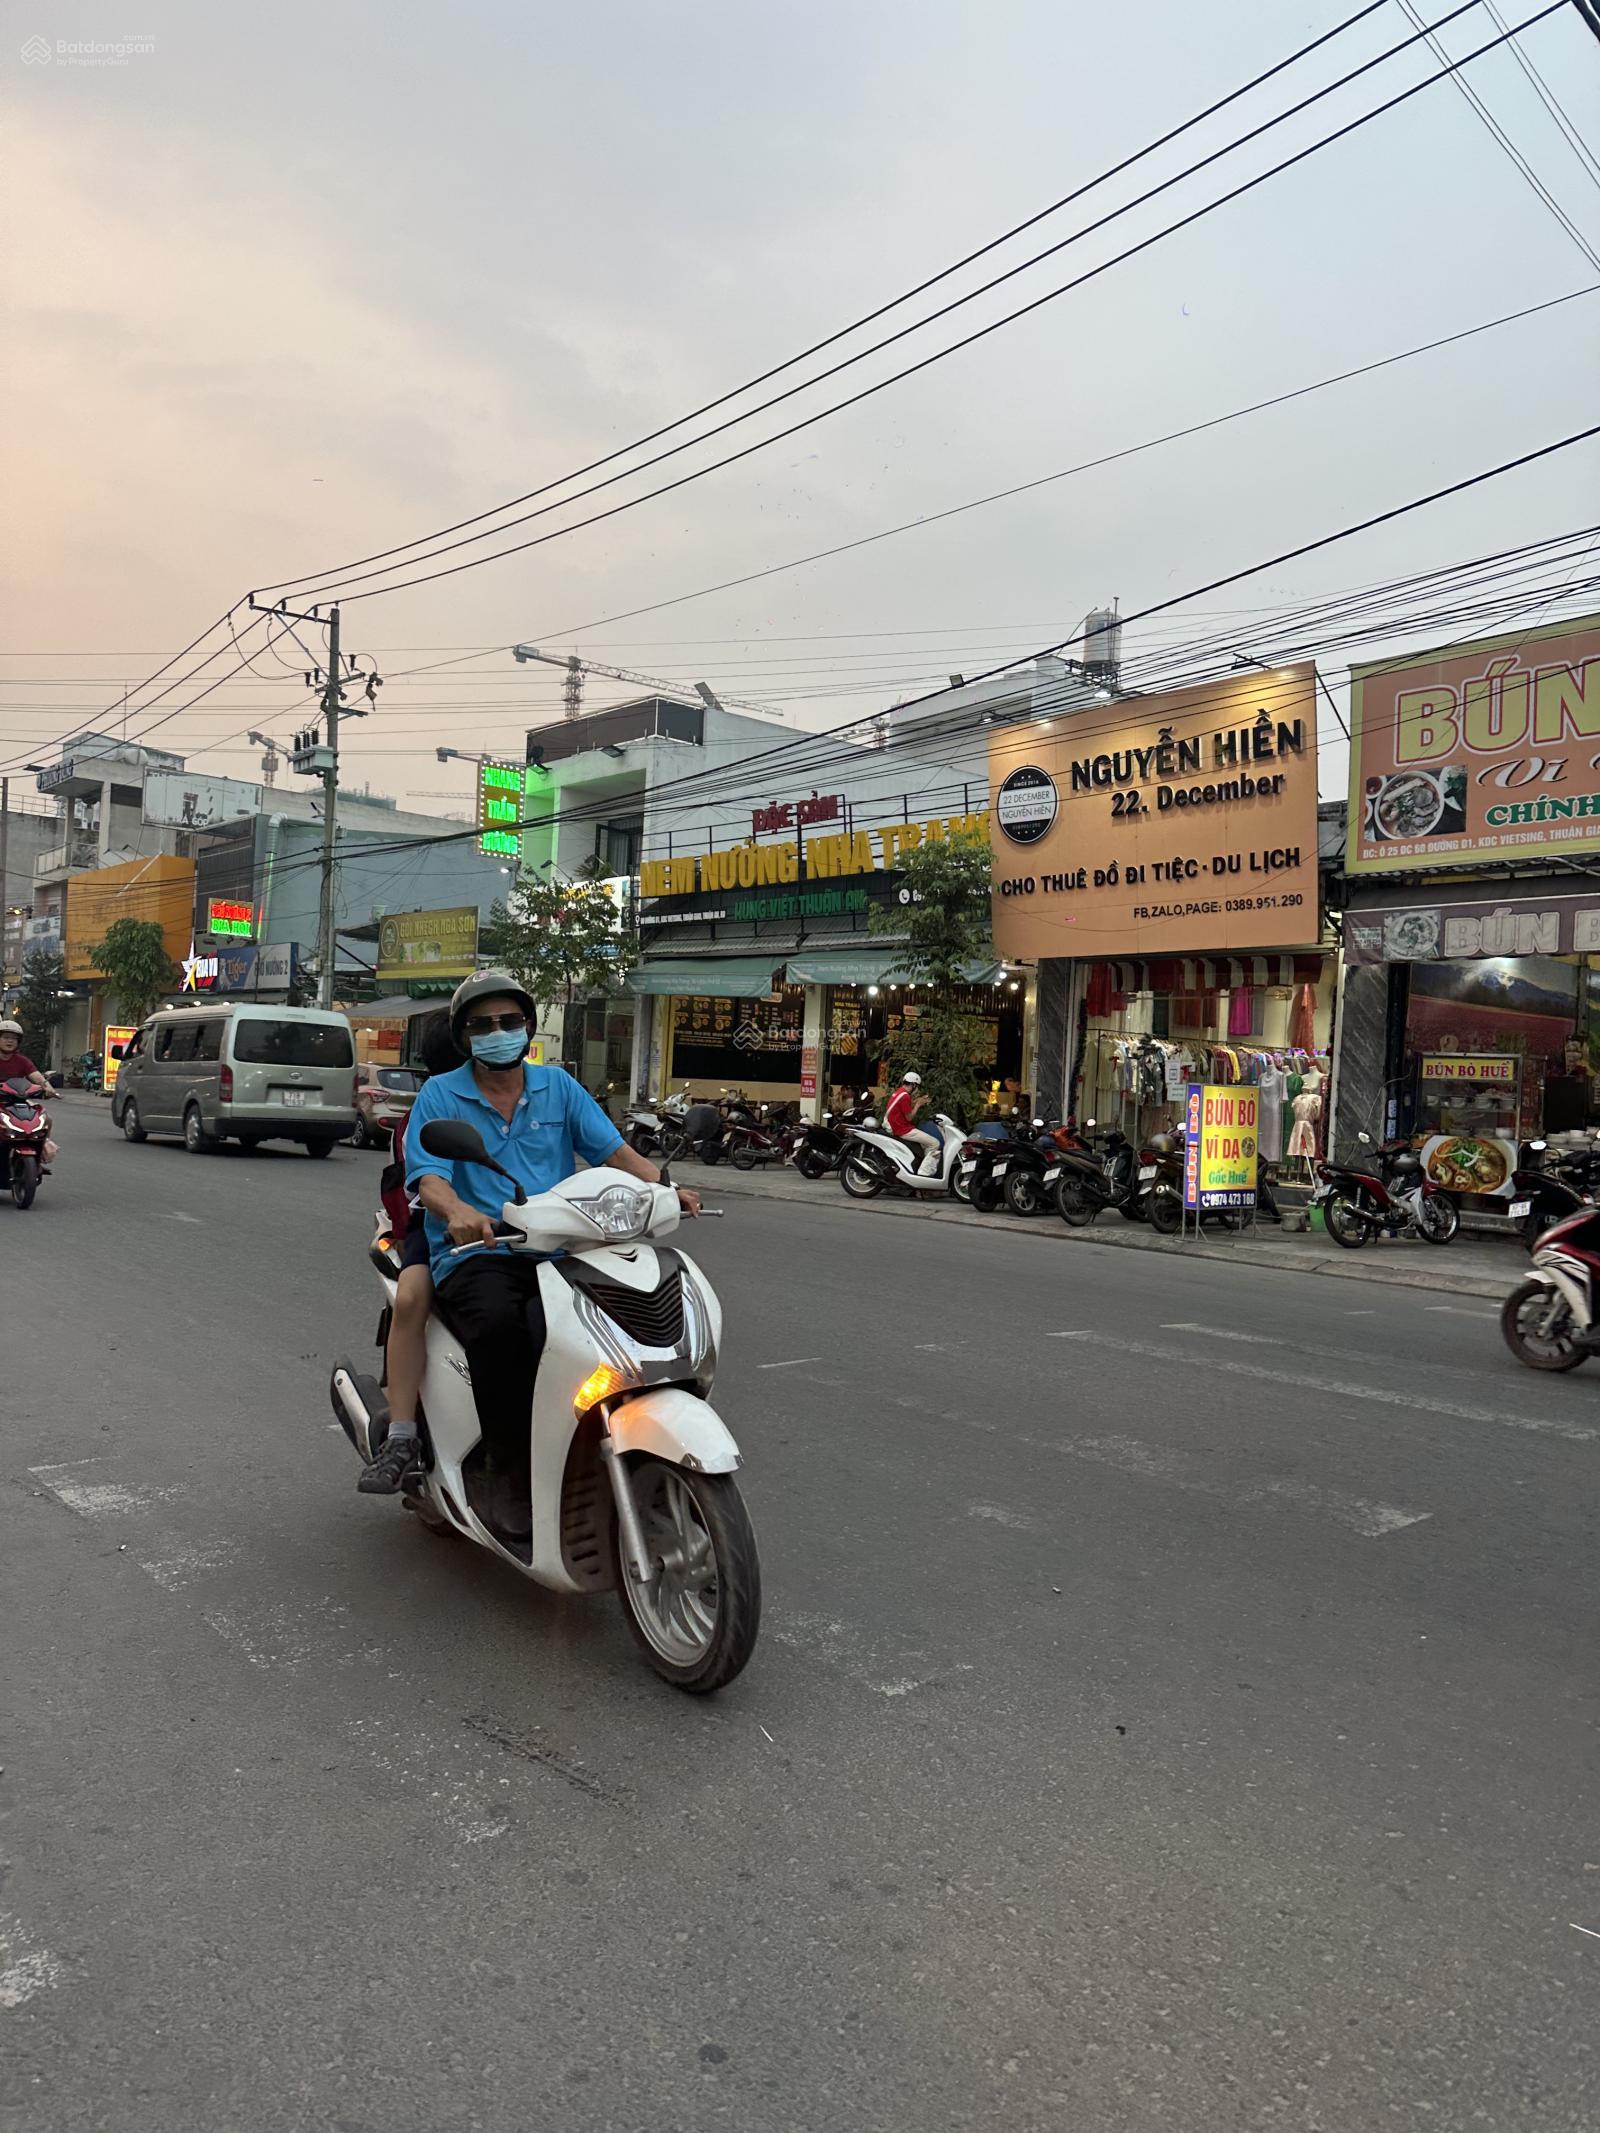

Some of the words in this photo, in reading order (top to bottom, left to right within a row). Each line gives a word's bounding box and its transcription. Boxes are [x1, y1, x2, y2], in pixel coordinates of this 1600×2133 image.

[1393, 655, 1600, 767] BÚN
[1071, 726, 1201, 791] NGUYỄN
[1213, 708, 1303, 766] HIỀN
[1003, 795, 1012, 805] 22
[1013, 790, 1050, 804] DECEMBER
[1111, 790, 1149, 817] 22.
[1157, 772, 1285, 810] December
[1485, 793, 1600, 826] CHÍNH
[1478, 835, 1498, 848] KDC
[1499, 830, 1547, 846] VIETSING,
[640, 856, 695, 897] NEM
[807, 830, 875, 879] NHA
[1000, 877, 1035, 896] CHO
[1041, 867, 1087, 892] THUÊ
[1093, 859, 1119, 887] ĐỒ
[1126, 866, 1146, 884] ĐI
[1212, 853, 1241, 875] DU
[1250, 847, 1301, 874] LỊCH
[211, 918, 230, 933] BIA
[1445, 908, 1560, 956] BÚN
[228, 956, 247, 981] Tiger
[1480, 1060, 1509, 1078] HUẾ
[1205, 1092, 1234, 1127] BÚN
[1237, 1092, 1256, 1128] BÒ
[1222, 1138, 1240, 1164] DẠ
